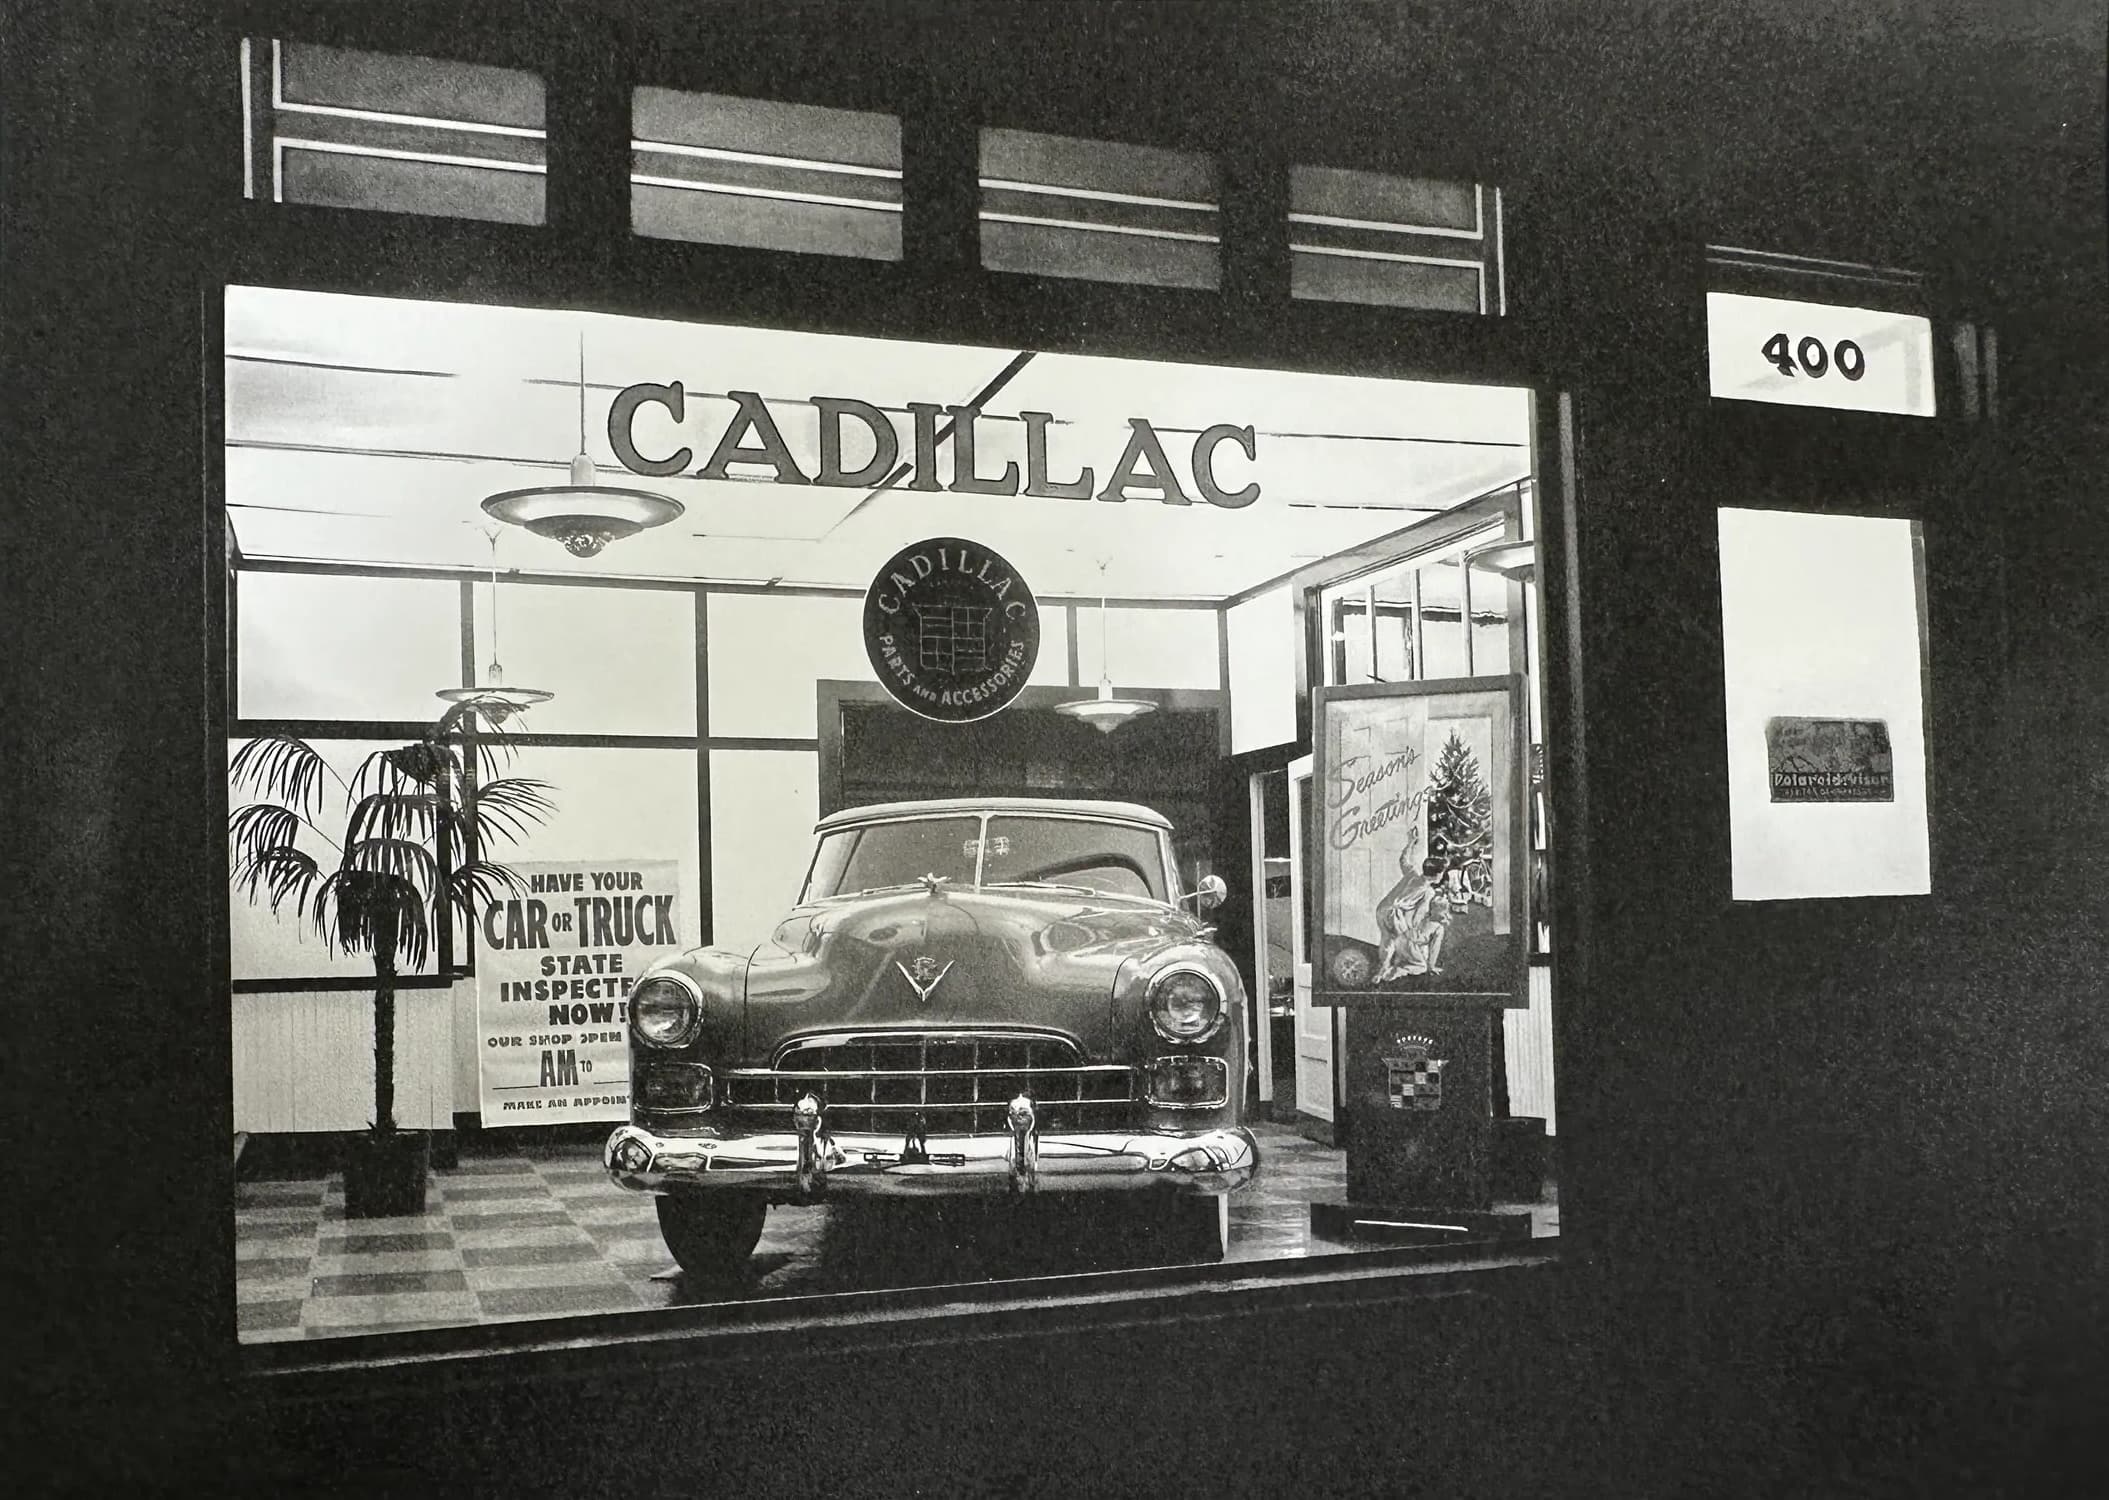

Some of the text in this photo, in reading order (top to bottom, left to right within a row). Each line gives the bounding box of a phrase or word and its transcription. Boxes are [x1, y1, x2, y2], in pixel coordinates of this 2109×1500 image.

[1761, 333, 1865, 381] 400
[607, 380, 1260, 508] CADILLAC
[878, 548, 1026, 620] CADILLAC
[879, 634, 1025, 706] PARTS AND ACCESSORIES
[530, 871, 643, 893] HAVE YOUR
[483, 895, 677, 950] CAR OR TRUCK
[540, 953, 624, 977] STATE
[549, 1002, 628, 1026] NOW!
[487, 1036, 523, 1048] OUR
[529, 1033, 573, 1047] SHOP
[540, 1049, 593, 1088] AM TO
[503, 1099, 543, 1111] MAKE
[548, 1098, 568, 1109] AN
